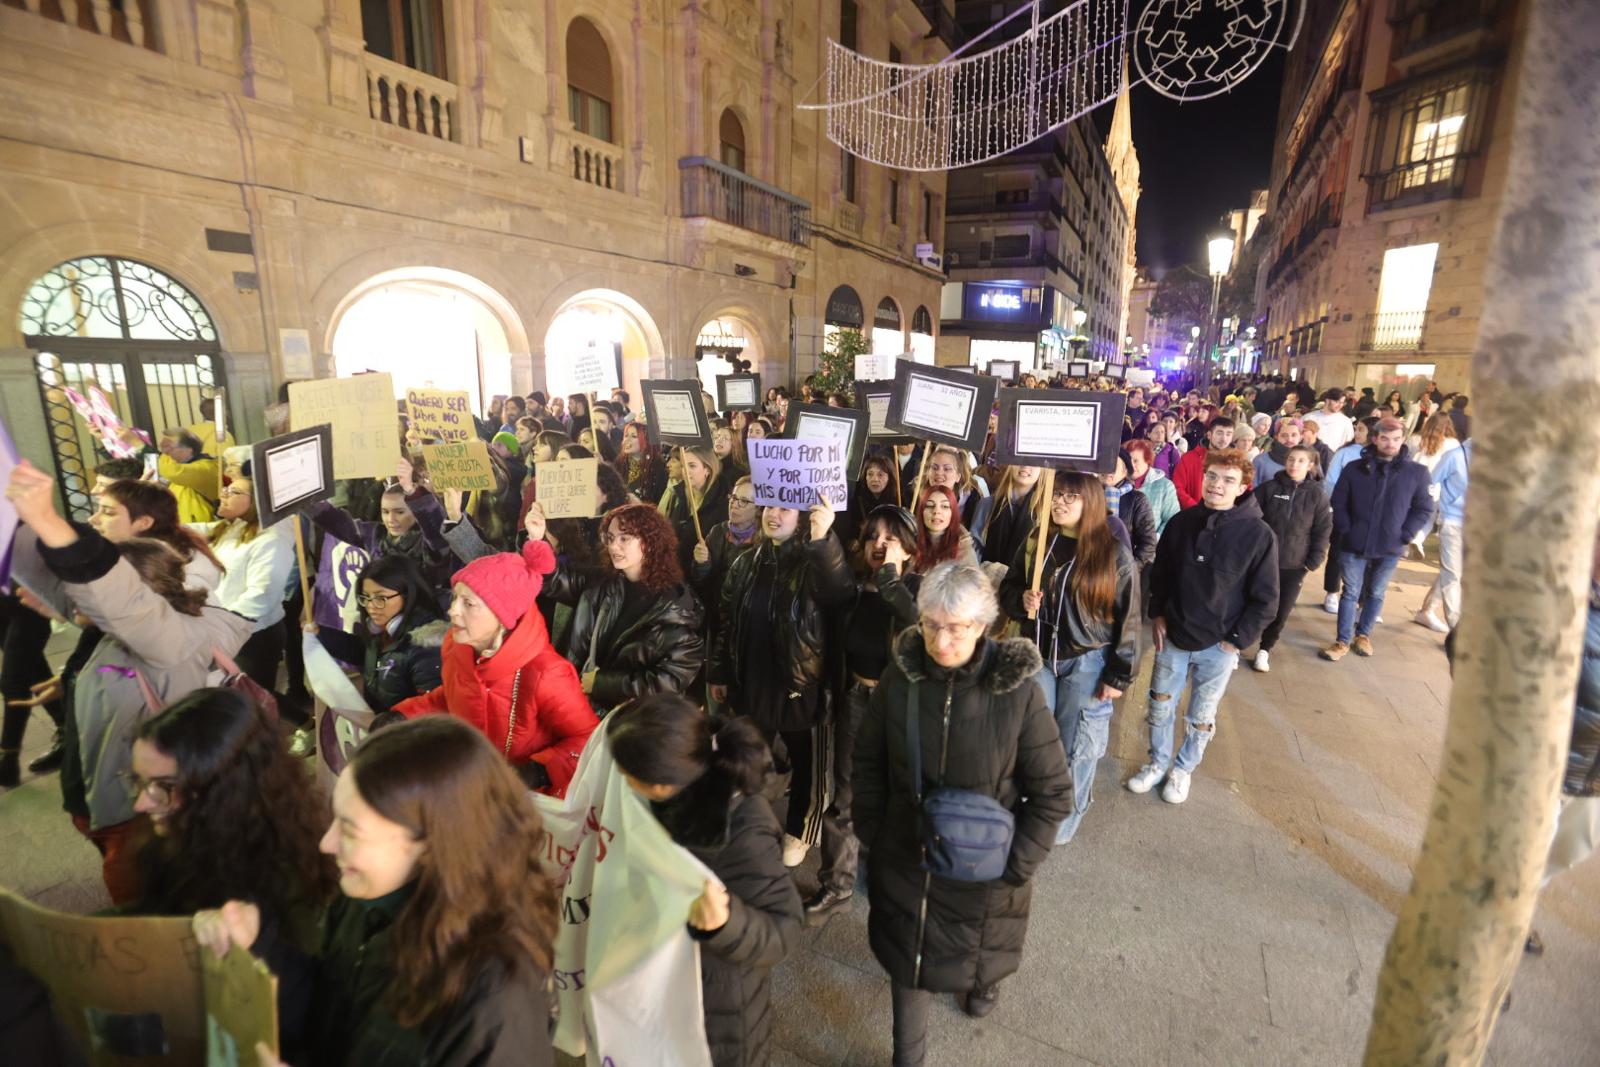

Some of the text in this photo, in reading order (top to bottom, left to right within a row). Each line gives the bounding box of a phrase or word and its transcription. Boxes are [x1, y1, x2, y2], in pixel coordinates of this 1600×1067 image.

[446, 396, 467, 412] SER
[442, 412, 459, 424] NO
[755, 442, 793, 461] LUCHO
[798, 444, 824, 462] POR
[428, 460, 444, 472] NO
[458, 459, 484, 472] GUSTA
[766, 466, 841, 484] Y POR TODAS
